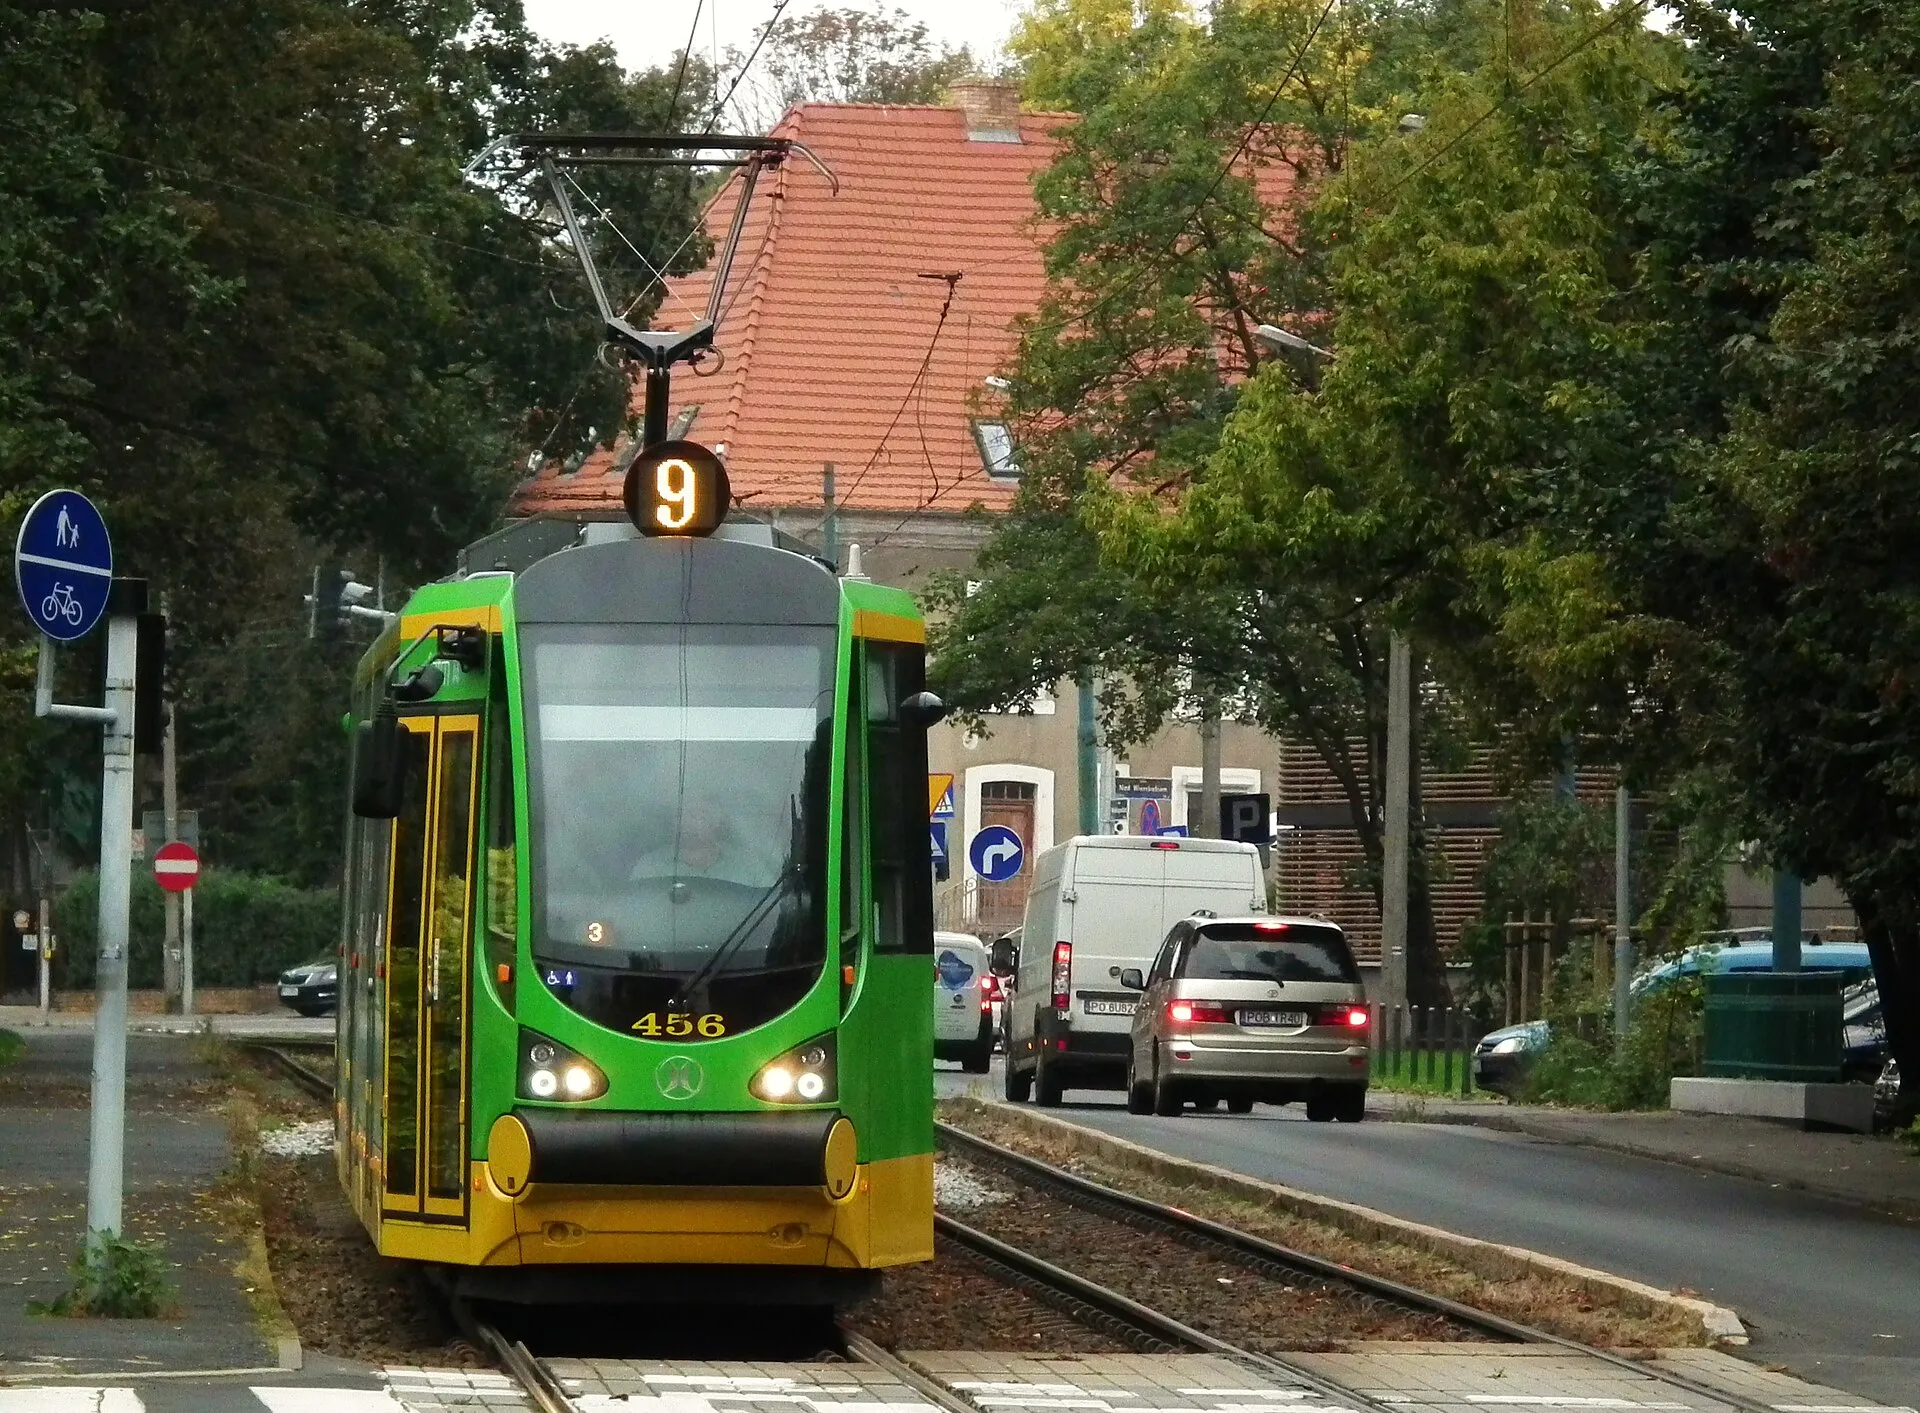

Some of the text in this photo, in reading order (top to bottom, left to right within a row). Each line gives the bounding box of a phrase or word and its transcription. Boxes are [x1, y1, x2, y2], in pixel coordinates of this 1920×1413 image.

[656, 459, 695, 528] 9
[1232, 800, 1260, 840] P
[588, 922, 602, 942] 3
[1091, 1002, 1106, 1012] PO
[631, 1012, 726, 1037] 456
